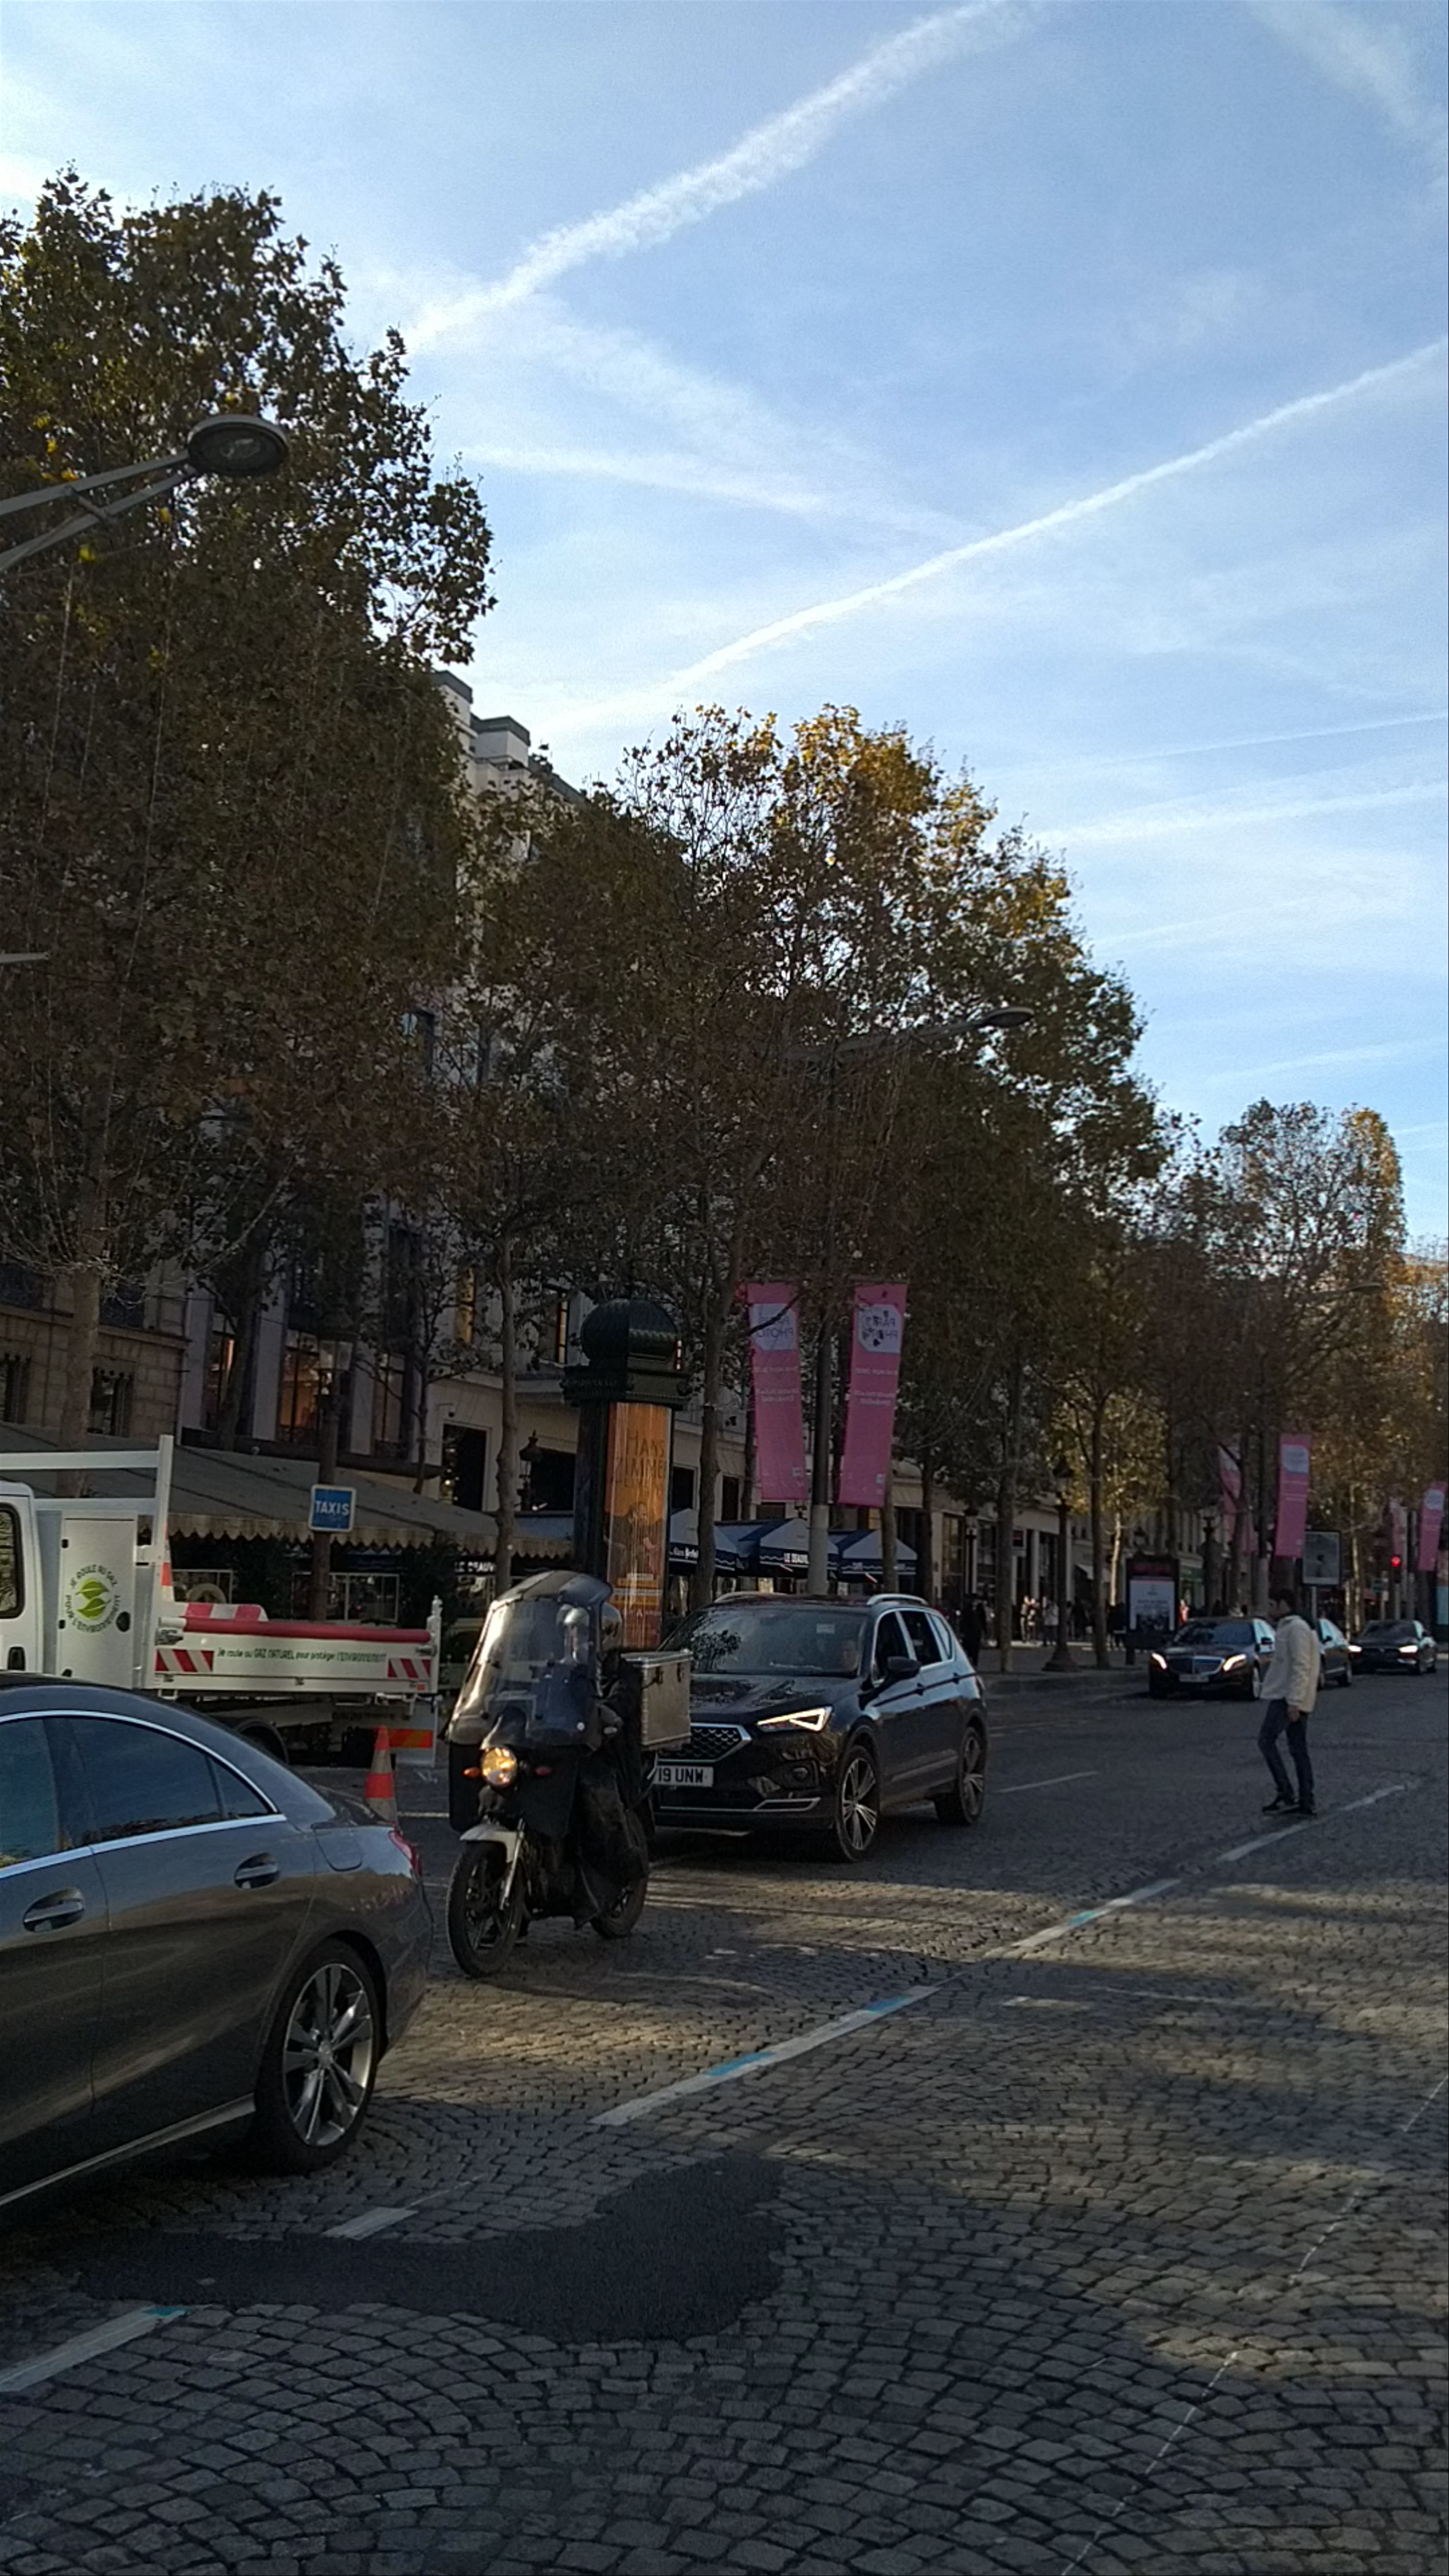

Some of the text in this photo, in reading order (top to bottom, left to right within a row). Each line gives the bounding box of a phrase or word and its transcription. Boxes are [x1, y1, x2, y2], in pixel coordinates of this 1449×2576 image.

[625, 1430, 665, 1458] HANS
[612, 1456, 666, 1479] ZIMME
[315, 1500, 349, 1516] TAXIS
[675, 1768, 703, 1783] UNW
